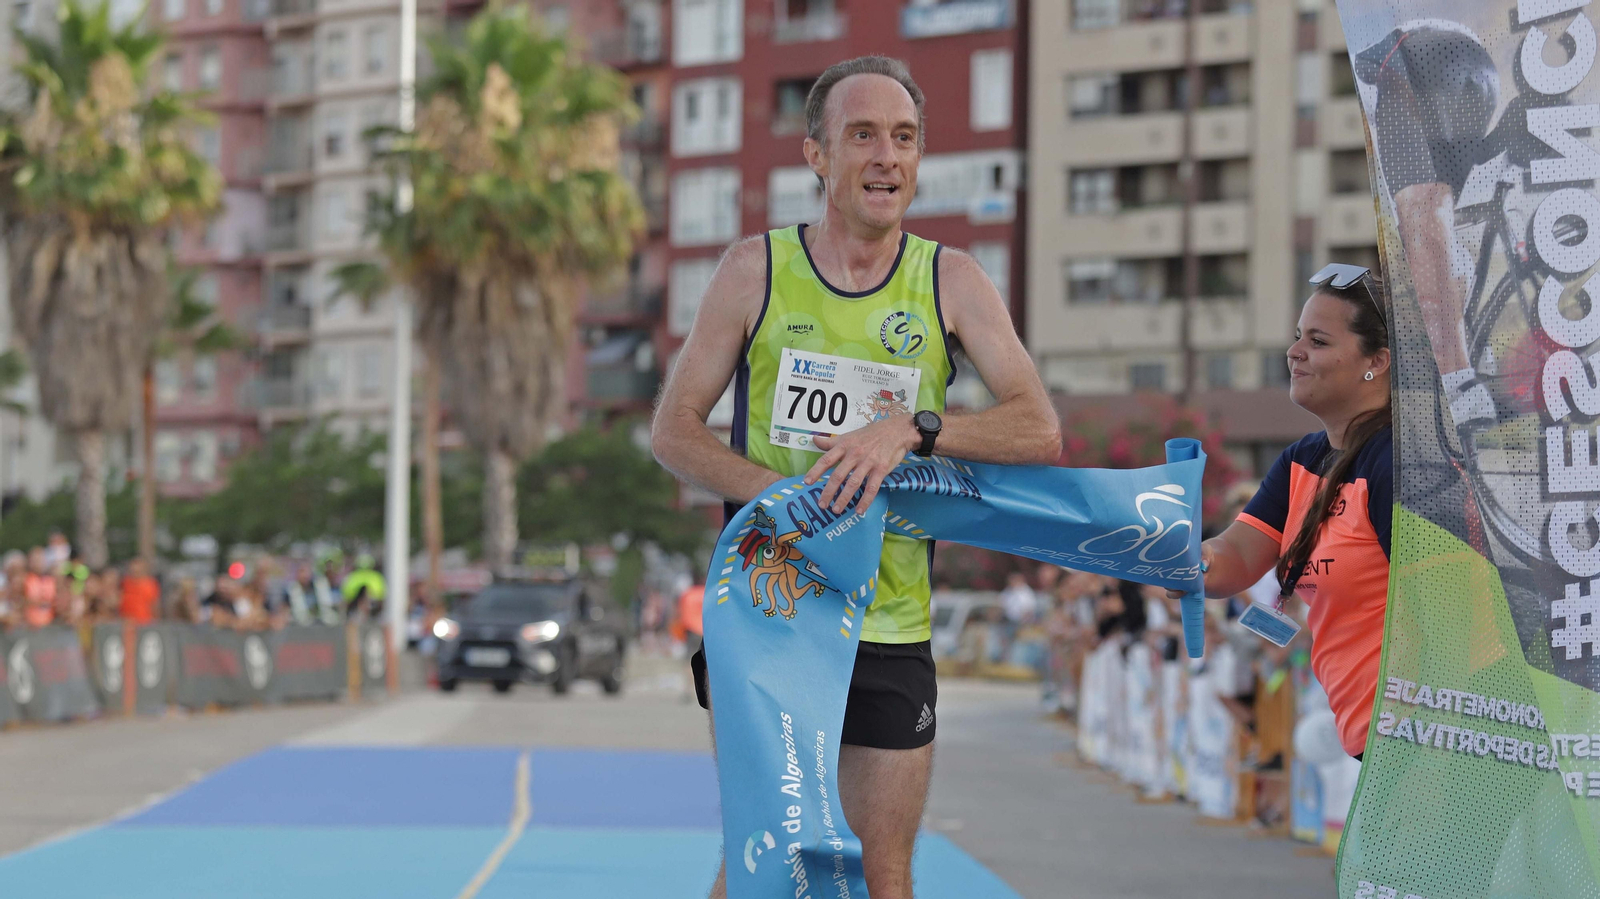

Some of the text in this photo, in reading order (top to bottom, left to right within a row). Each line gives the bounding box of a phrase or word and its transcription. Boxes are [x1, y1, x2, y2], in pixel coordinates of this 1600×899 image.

[881, 313, 898, 349] ALGECIRAS
[792, 358, 812, 375] XX
[811, 361, 836, 371] Carrera
[810, 369, 836, 379] Popular
[853, 365, 901, 379] FIDEL JORGE
[787, 385, 848, 427] 700
[1013, 546, 1200, 581] SPECIAL BIKES
[814, 730, 826, 783] Algeciras
[781, 712, 808, 899] Bahía de Algeciras
[818, 785, 828, 798] de
[821, 800, 833, 828] Bahía
[829, 836, 843, 851] de
